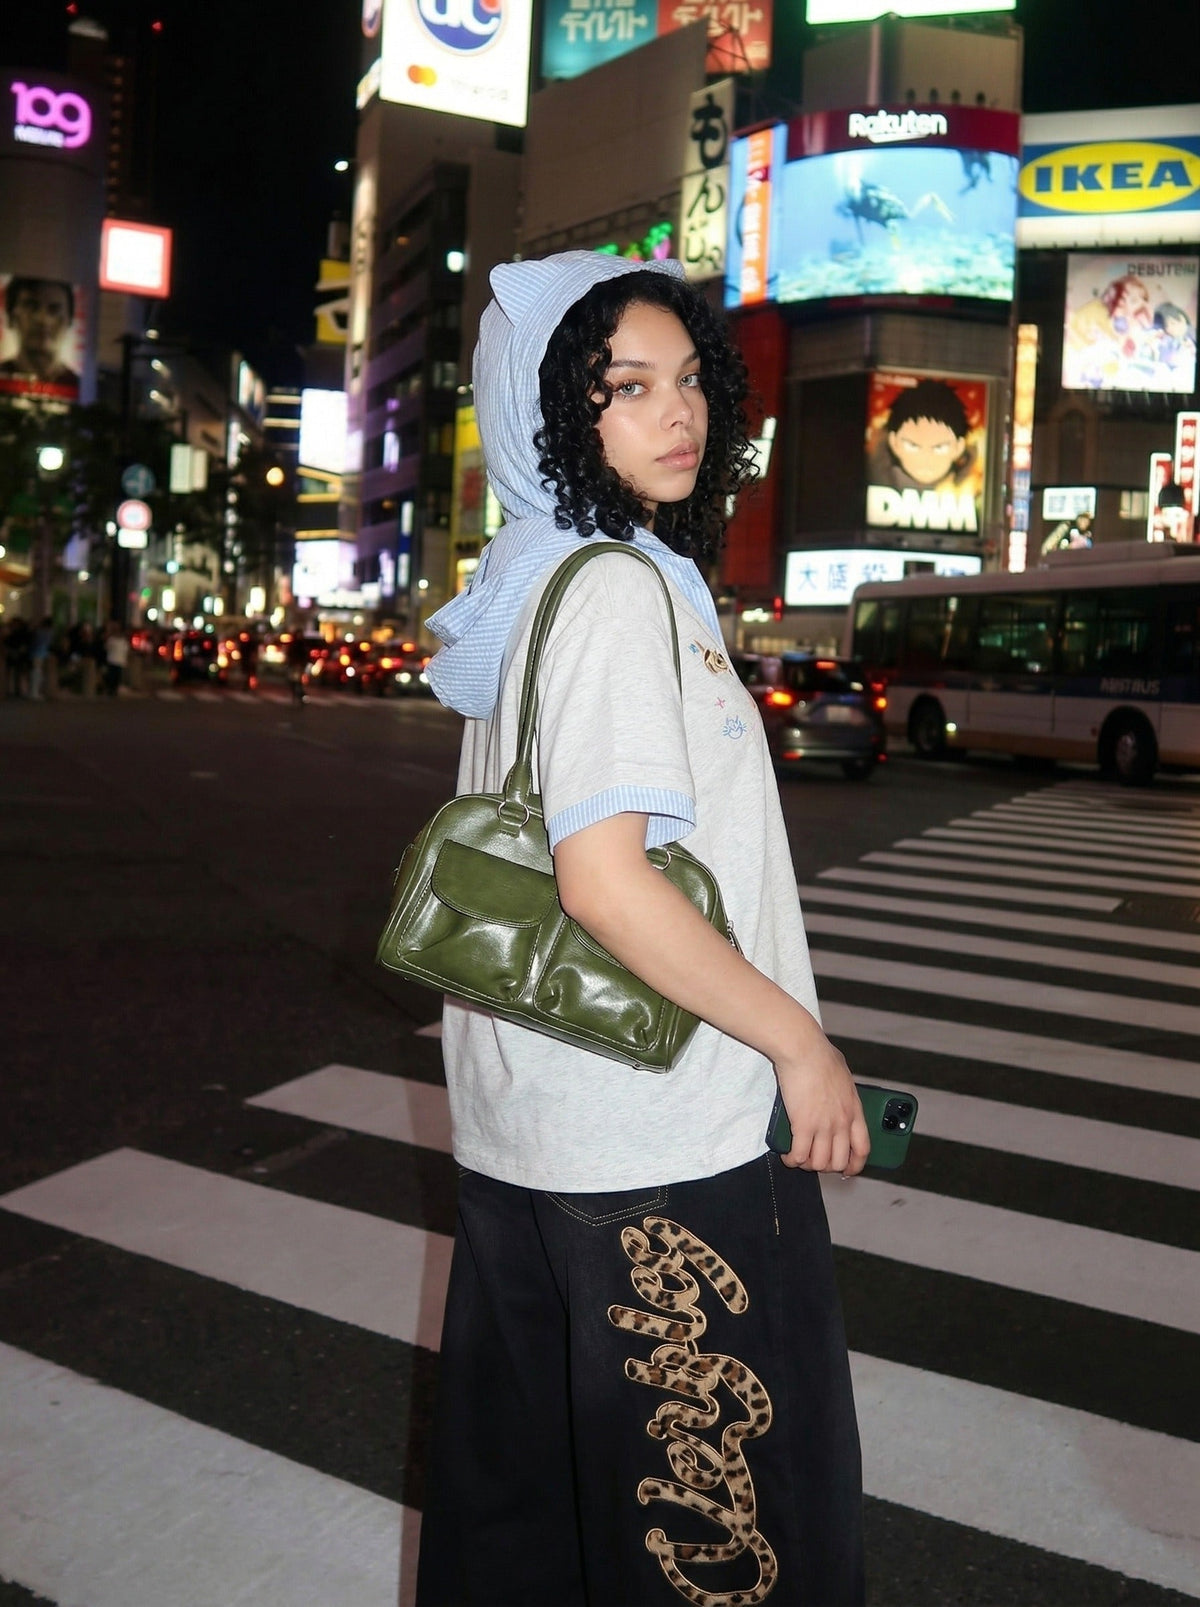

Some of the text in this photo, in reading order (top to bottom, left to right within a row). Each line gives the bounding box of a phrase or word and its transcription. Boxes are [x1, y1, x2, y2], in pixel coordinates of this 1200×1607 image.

[11, 81, 92, 149] 109
[848, 109, 948, 140] Rakuten
[684, 93, 728, 272] もんじゃ
[1035, 160, 1193, 193] IKEA
[866, 485, 978, 533] DMM
